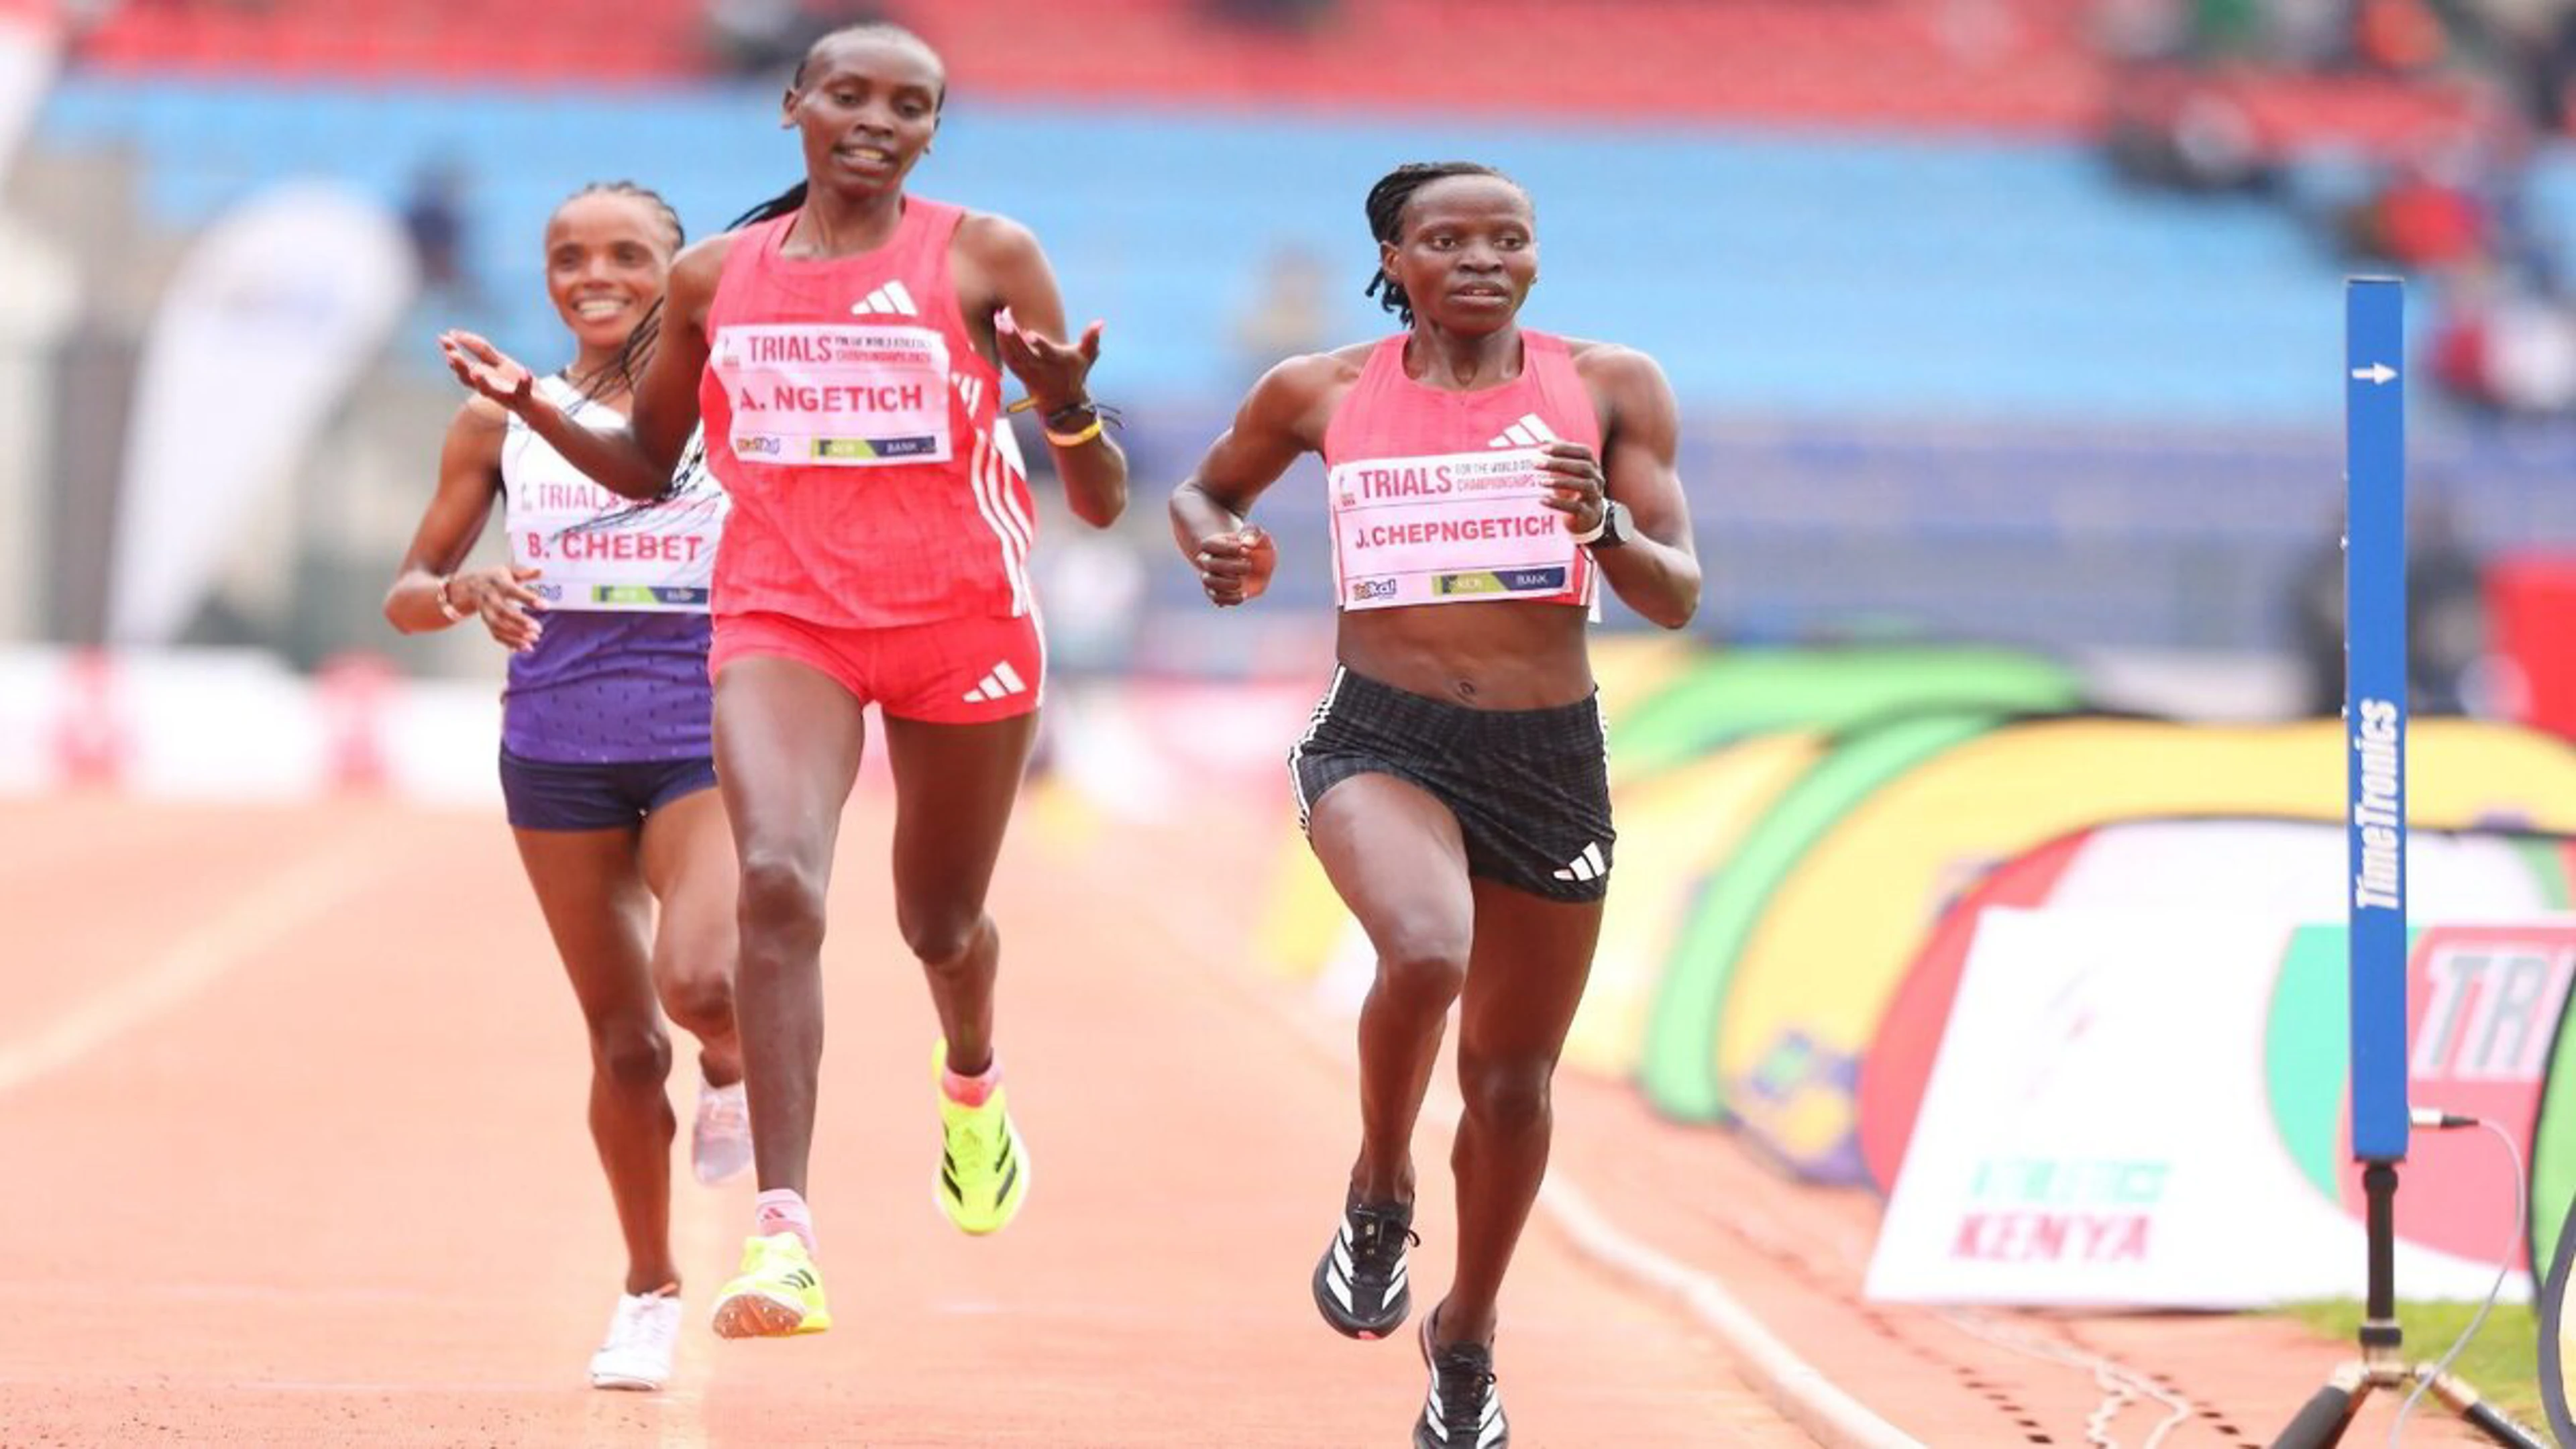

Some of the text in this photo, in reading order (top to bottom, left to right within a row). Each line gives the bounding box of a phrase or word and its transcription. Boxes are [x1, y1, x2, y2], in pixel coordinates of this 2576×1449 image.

[748, 335, 832, 362] TRIALS
[739, 384, 923, 413] A. NGETICH
[1358, 465, 1452, 500] TRIALS
[527, 532, 704, 561] B. CHEBET
[1516, 574, 1549, 586] BANK
[2353, 698, 2400, 910] TimeTronics
[1949, 1212, 2152, 1262] KENYA
